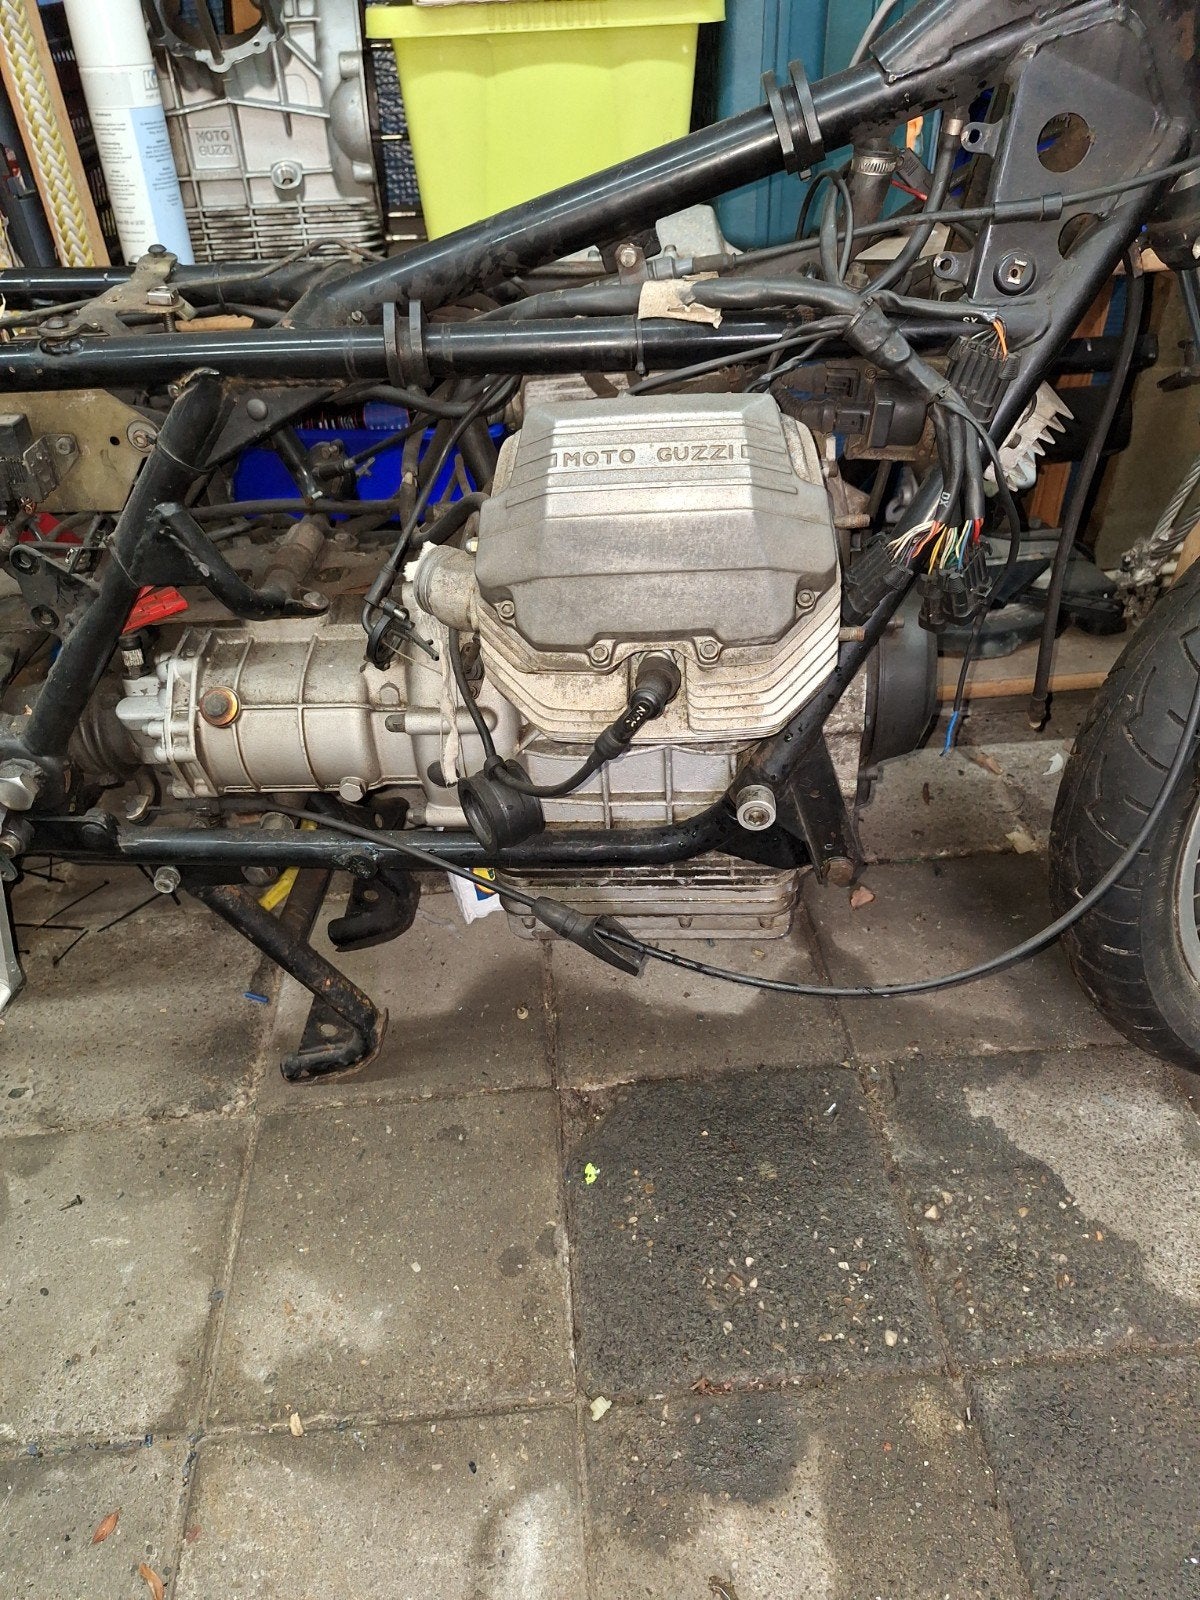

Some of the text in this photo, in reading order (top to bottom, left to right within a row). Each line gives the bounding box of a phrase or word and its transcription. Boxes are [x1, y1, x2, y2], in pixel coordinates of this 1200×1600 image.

[195, 130, 229, 143] MOTO
[199, 144, 233, 156] GUZZI
[562, 444, 734, 468] MOTO GUZZI
